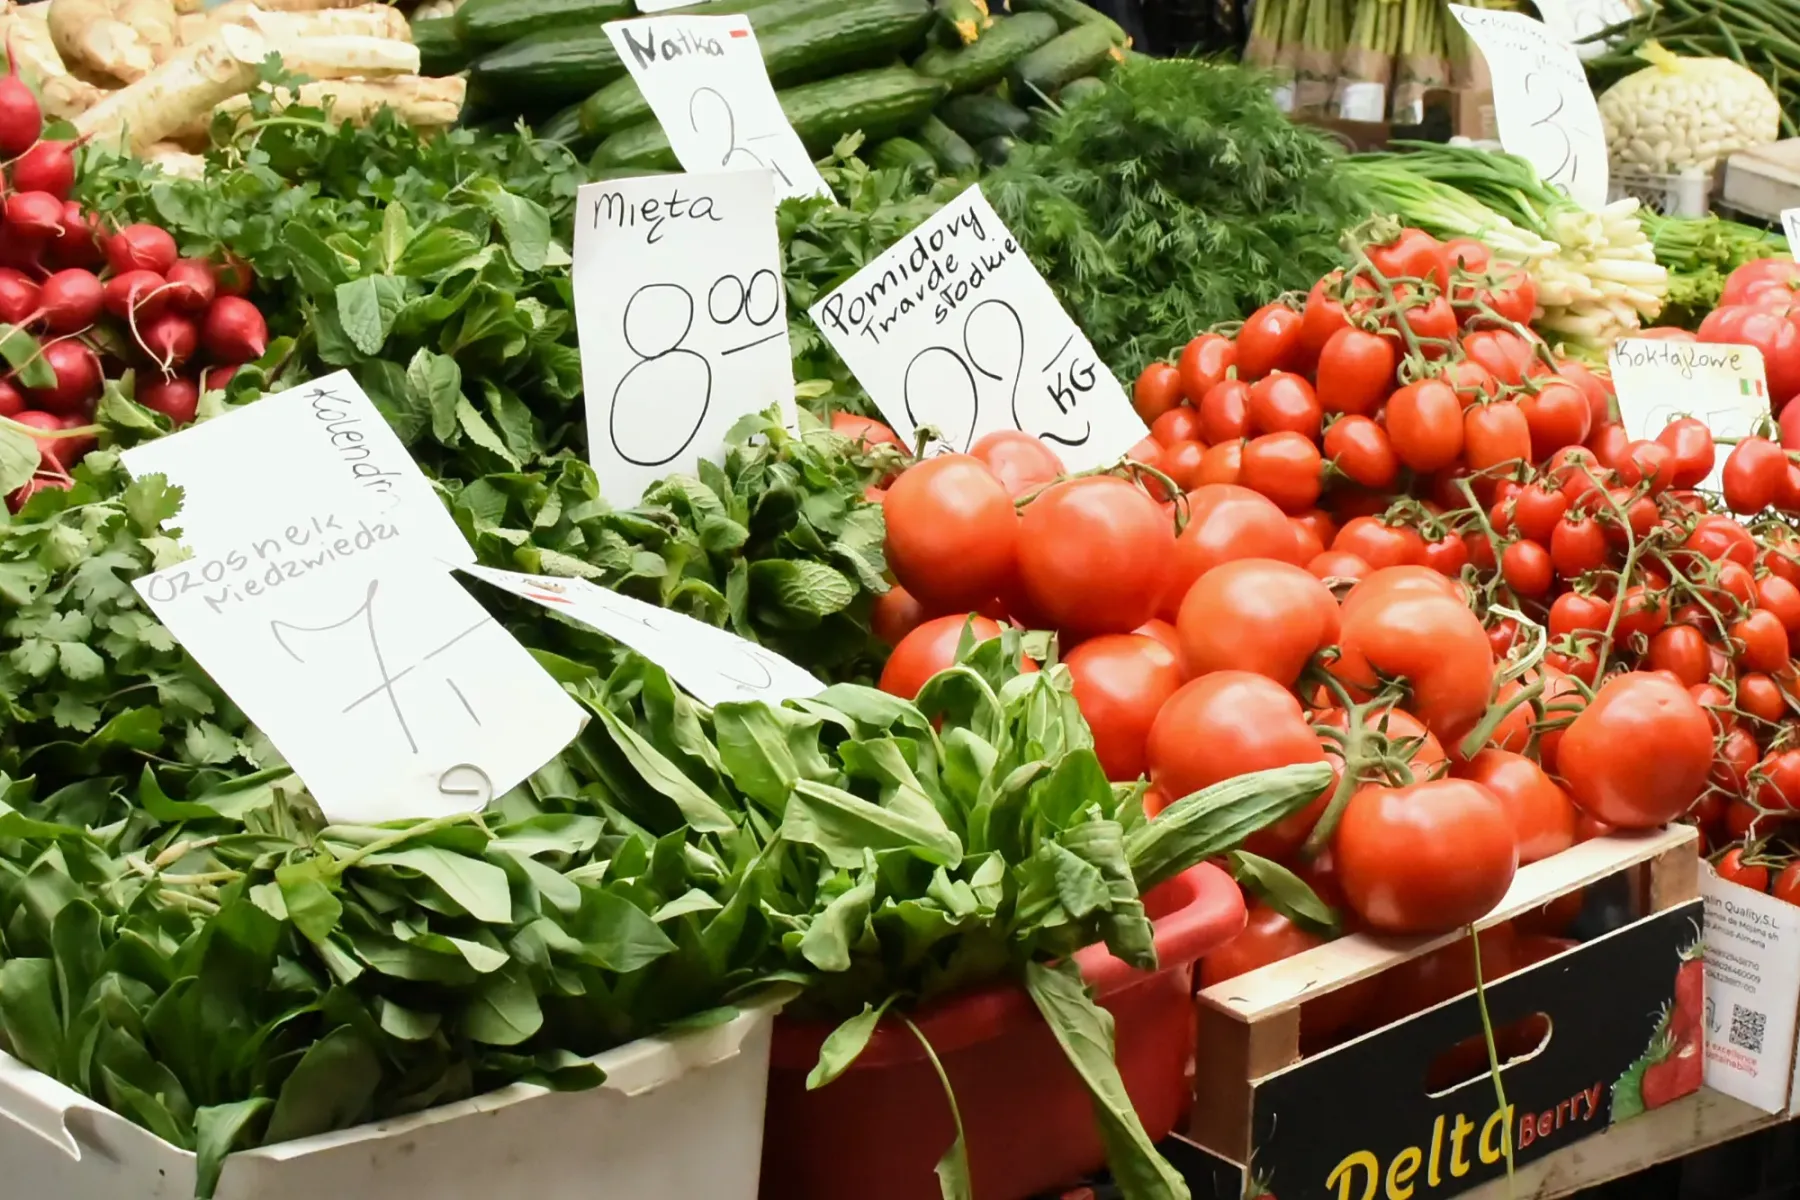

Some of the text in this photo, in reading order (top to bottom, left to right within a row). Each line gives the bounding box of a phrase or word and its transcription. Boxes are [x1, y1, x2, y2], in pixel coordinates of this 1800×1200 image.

[621, 26, 725, 70] Natka
[593, 189, 724, 244] Mięta
[1324, 1081, 1602, 1200] Delta Berry
